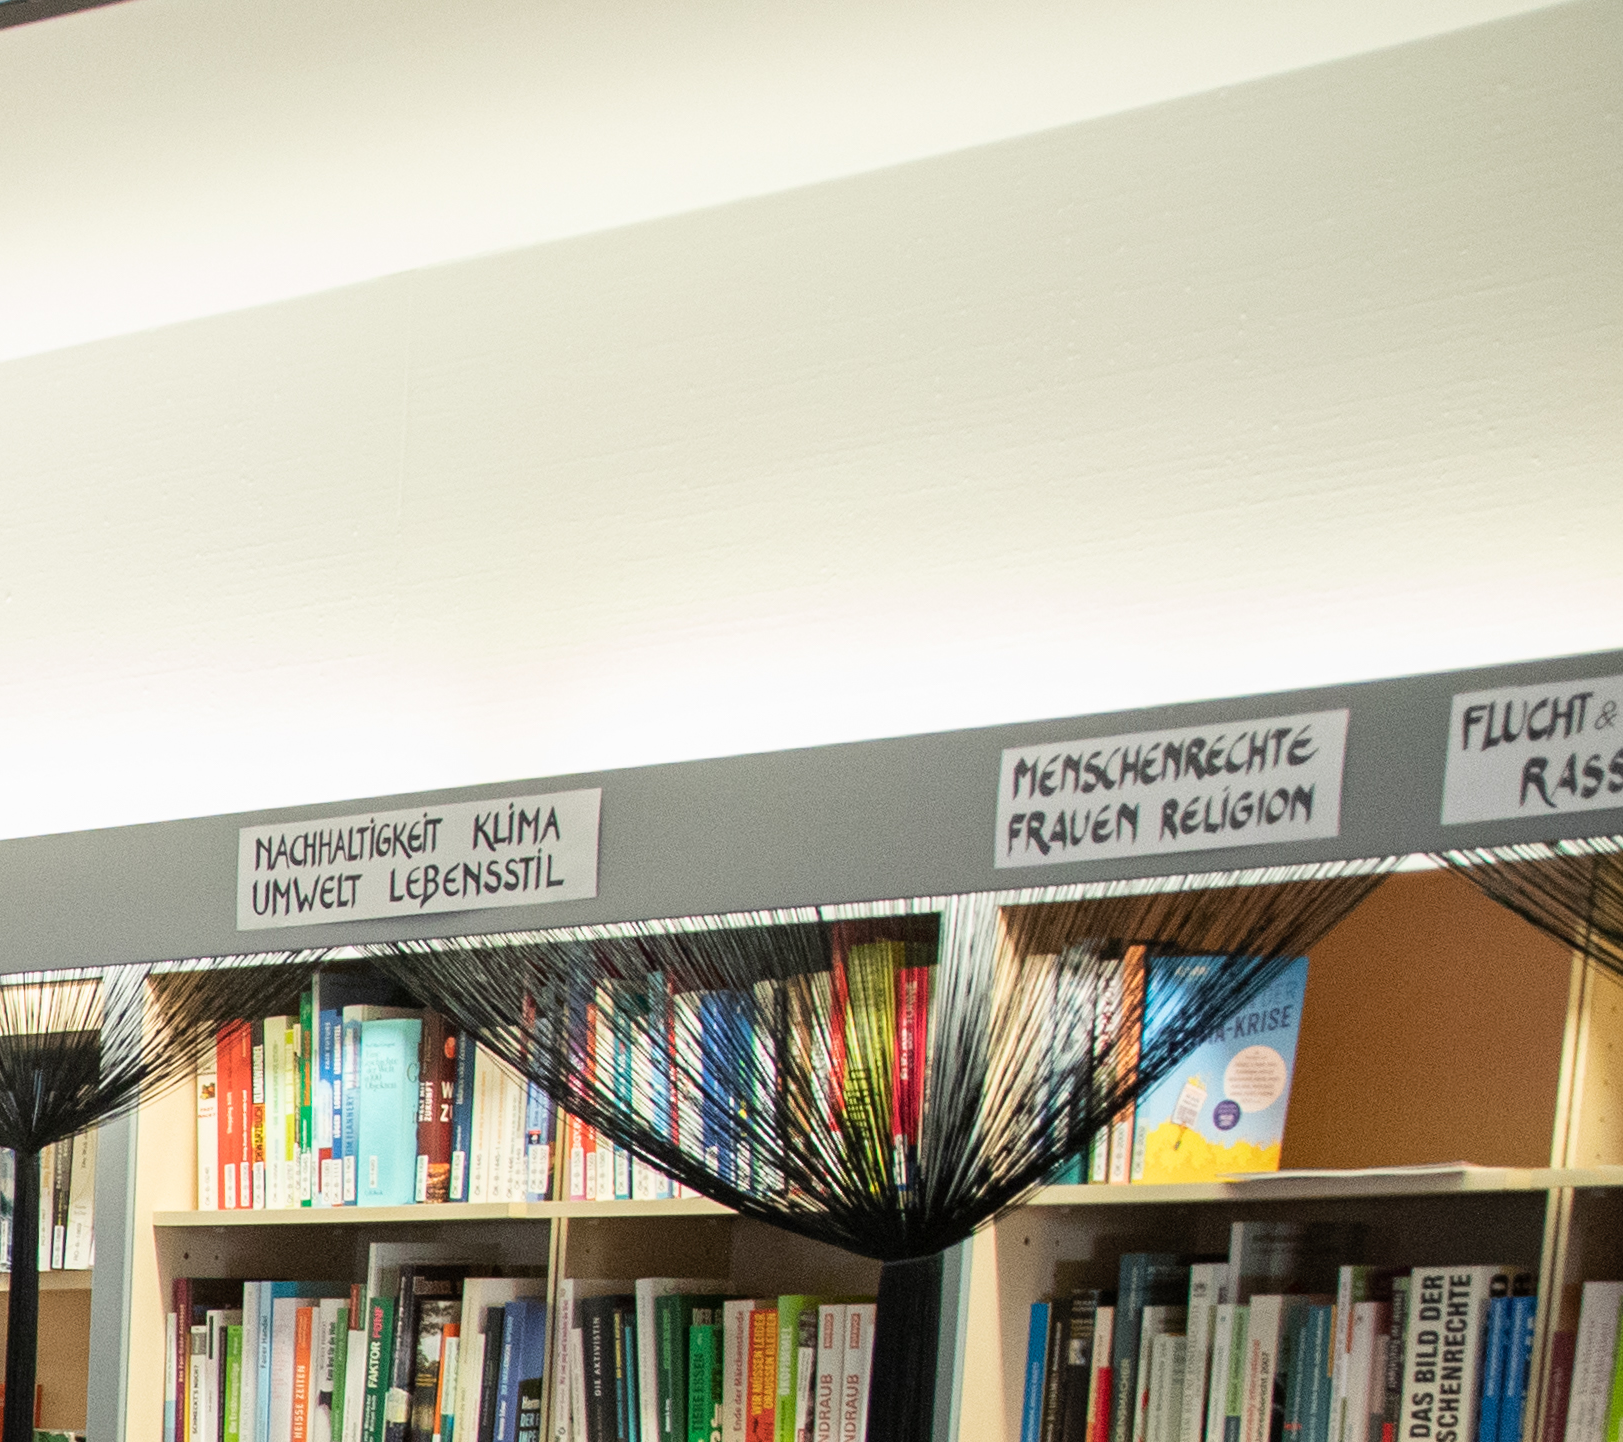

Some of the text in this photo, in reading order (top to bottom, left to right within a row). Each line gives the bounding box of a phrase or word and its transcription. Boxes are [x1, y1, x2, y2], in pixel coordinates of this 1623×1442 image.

[1463, 691, 1593, 752] FLUCHT
[1012, 724, 1319, 801] MENSCHENRECHTE
[255, 801, 561, 870] NACHHALTIGKEIT KLIMA
[1007, 783, 1317, 857] FRAUEN RELIGION
[252, 847, 564, 917] UMWELT LEBENSSTIL
[367, 1341, 381, 1388] FAKTOR
[1409, 1273, 1446, 1439] DAS BILD DER
